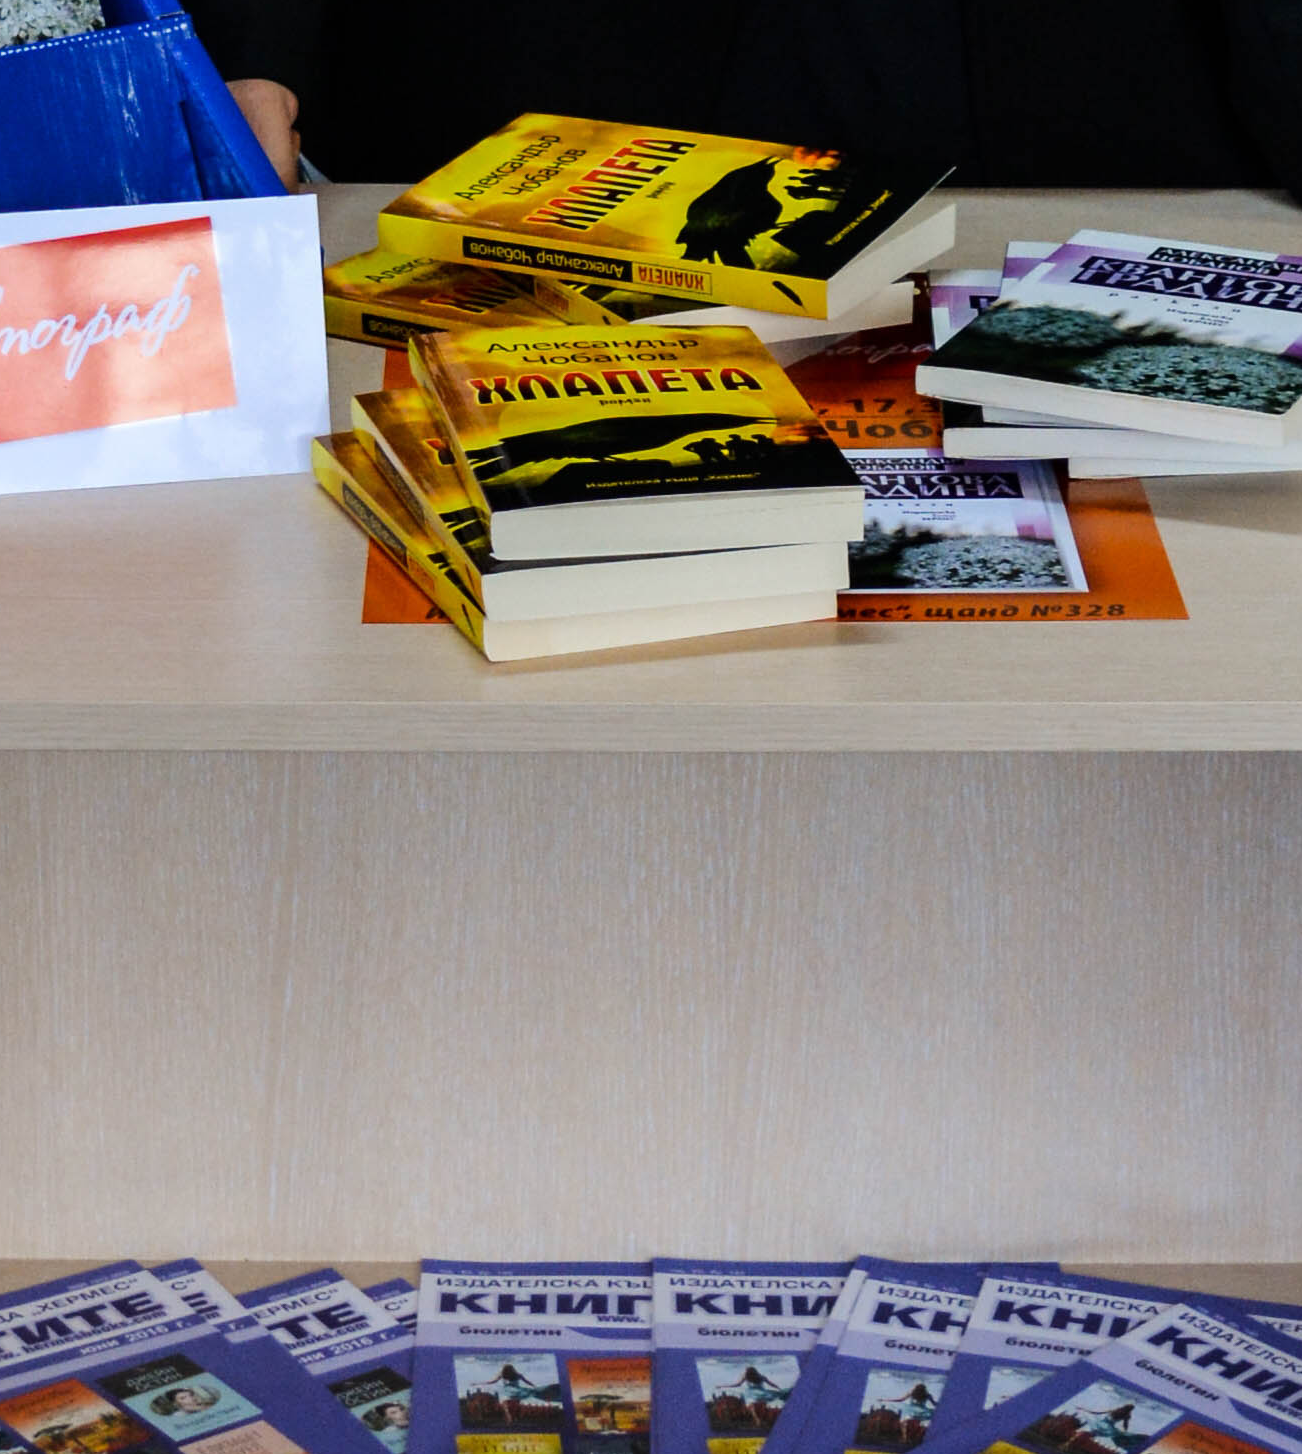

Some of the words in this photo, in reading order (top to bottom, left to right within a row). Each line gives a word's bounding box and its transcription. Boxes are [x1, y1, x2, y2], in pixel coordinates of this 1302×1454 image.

[470, 242, 533, 265] Чобанов
[536, 250, 624, 279] Александър
[637, 264, 705, 291] ХЛАПЕТА
[486, 334, 699, 355] Александър
[521, 347, 679, 366] Чобанов
[465, 366, 763, 407] ХЛАПЕТА
[668, 1276, 835, 1290] ИЗДАТЕЛСКА
[125, 1325, 169, 1344] 2016
[459, 1324, 562, 1338] бюлетин
